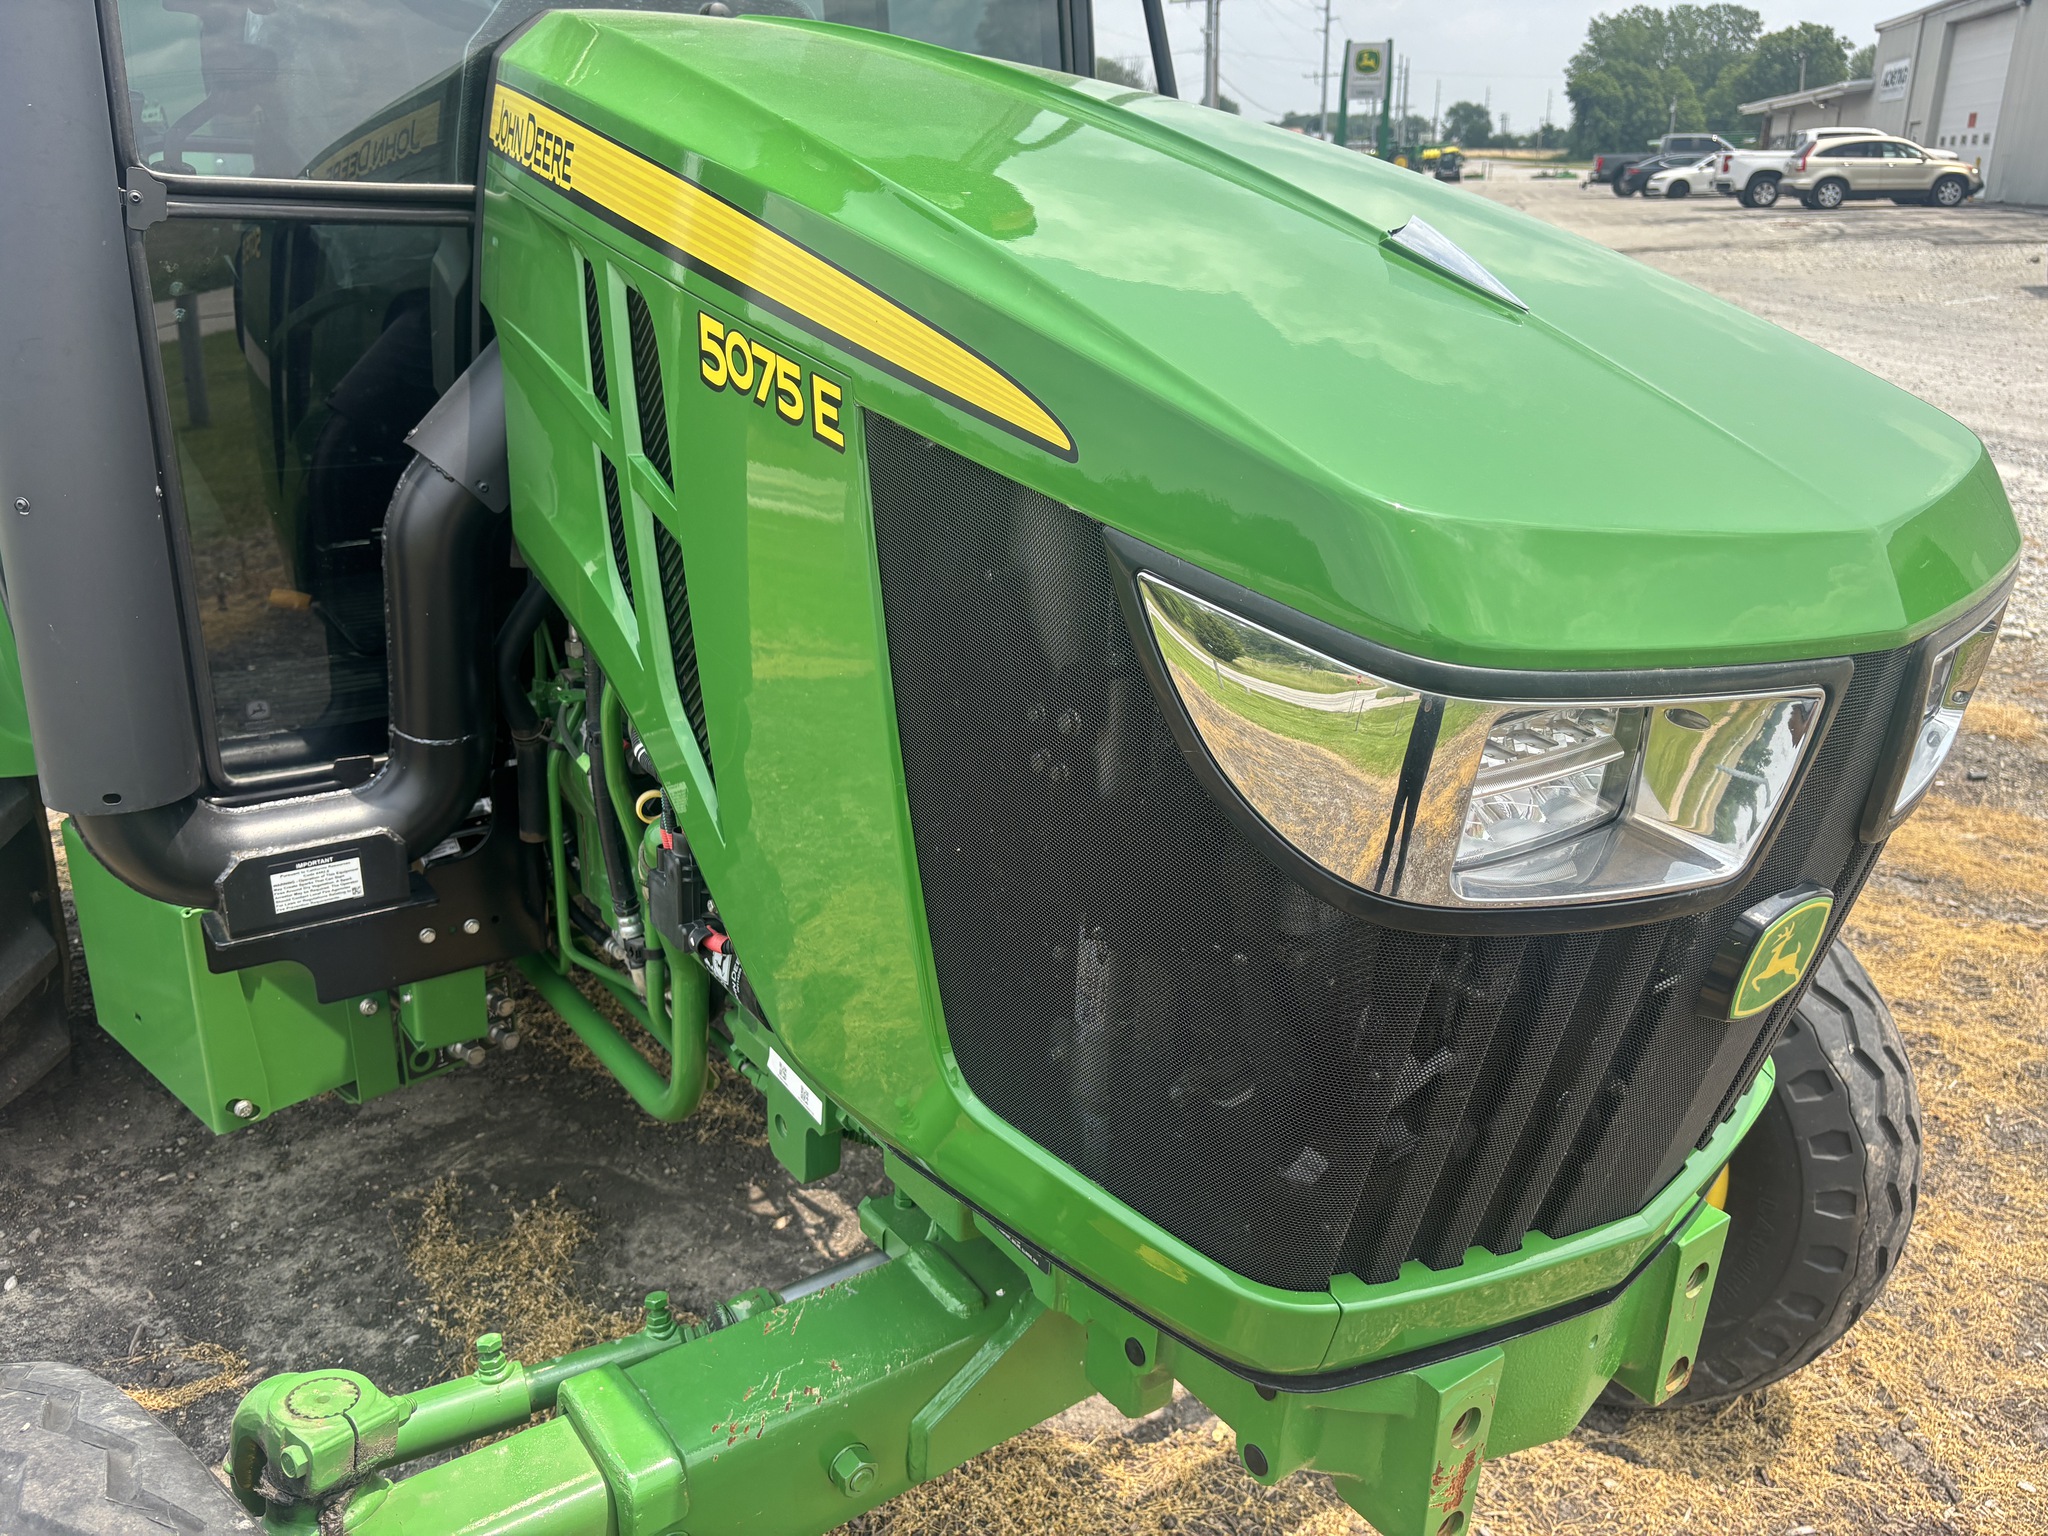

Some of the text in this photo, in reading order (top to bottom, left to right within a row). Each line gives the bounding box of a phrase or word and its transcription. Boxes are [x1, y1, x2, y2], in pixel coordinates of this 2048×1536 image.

[495, 99, 574, 186] JOHN DEERE
[698, 310, 846, 454] 5075 E
[296, 857, 334, 869] IMPORTANT
